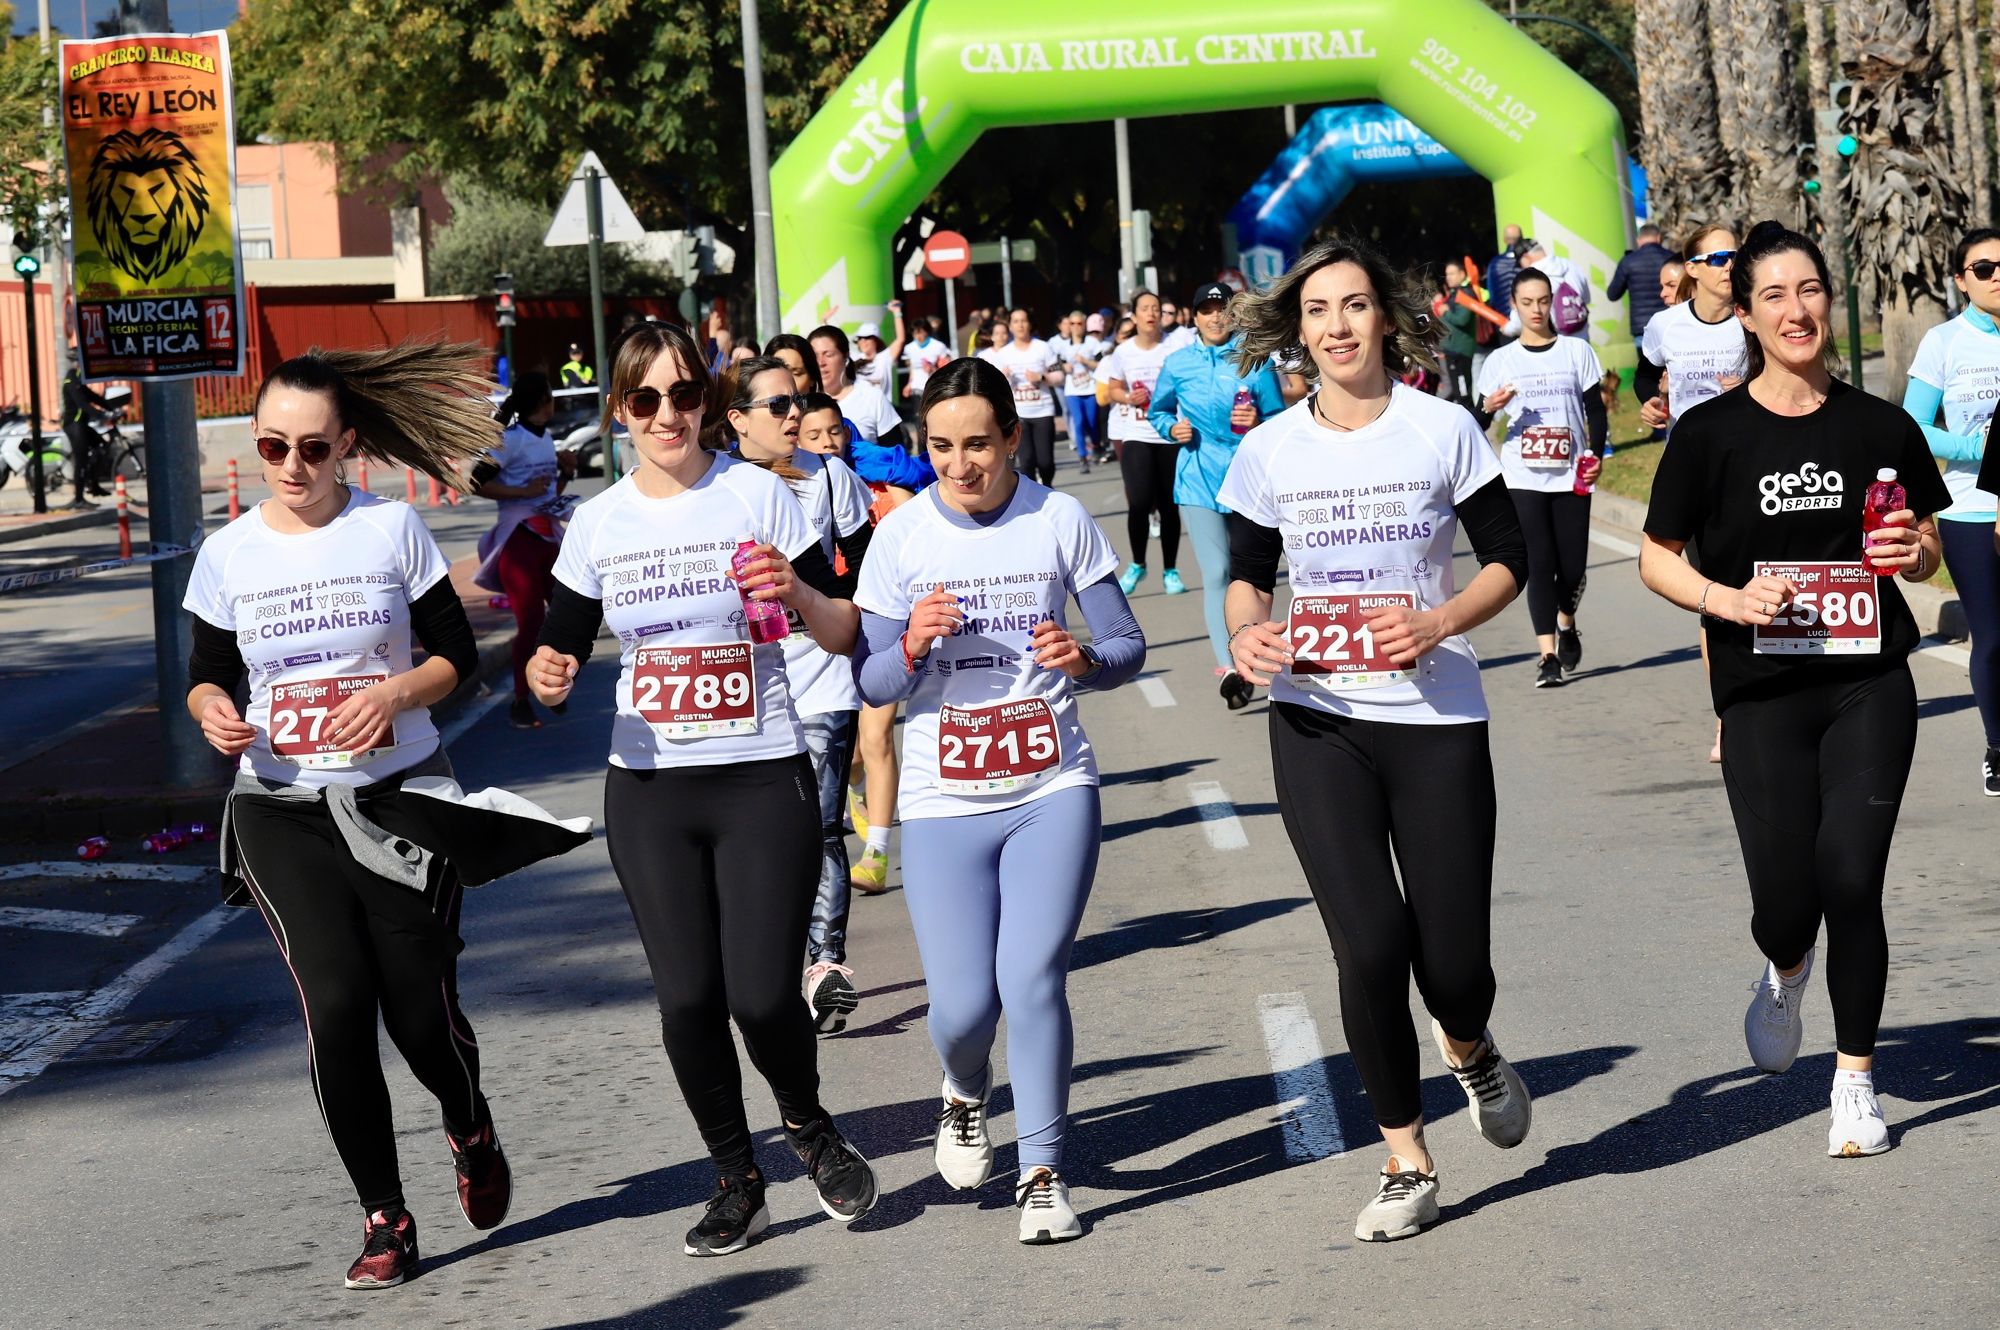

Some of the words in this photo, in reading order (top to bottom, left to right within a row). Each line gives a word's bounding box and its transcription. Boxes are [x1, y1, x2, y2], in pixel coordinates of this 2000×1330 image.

[960, 42, 1051, 74] CAJA
[1059, 37, 1189, 70] RURAL
[1195, 29, 1377, 65] CENTRAL
[69, 54, 106, 81] GRAN
[107, 46, 146, 67] CIRCO
[149, 46, 216, 74] ALASKA
[1419, 38, 1460, 74] 902
[1457, 67, 1498, 101] 104
[1496, 95, 1537, 130] 102
[69, 94, 93, 119] EL
[98, 91, 140, 119] REY
[148, 85, 217, 114] LEÓN
[1409, 57, 1523, 142] www.ruralcentral.es
[828, 79, 928, 185] CRC
[1353, 118, 1430, 145] UNIV
[1353, 144, 1411, 161] Instituto
[106, 299, 198, 324] MURCIA
[205, 305, 231, 340] 12
[82, 312, 105, 345] 24
[109, 323, 153, 335] RECINTO
[157, 321, 199, 333] FERIAL
[112, 336, 138, 356] LA
[142, 333, 200, 355] FICA
[1970, 366, 2000, 374] CARRERA
[1522, 438, 1570, 455] 2476
[1276, 494, 1294, 504] VIII
[1296, 490, 1340, 500] CARRERA
[1342, 489, 1355, 498] DE
[1358, 488, 1370, 497] LA
[1373, 483, 1405, 495] MUJER
[1407, 480, 1431, 491] 2023
[1298, 509, 1329, 525] POR
[1332, 499, 1355, 521] MÍ
[1359, 504, 1371, 519] Y
[1374, 502, 1407, 518] POR
[1786, 497, 1839, 510] SPORTS
[1305, 521, 1431, 548] COMPAÑERAS
[596, 558, 611, 569] VIII
[613, 551, 651, 565] CARRERA
[653, 548, 666, 558] DE
[669, 547, 681, 556] LA
[684, 543, 716, 554] MUJER
[719, 541, 739, 551] 202
[612, 570, 639, 586] POR
[642, 559, 665, 581] MÍ
[669, 563, 681, 577] Y
[684, 559, 718, 575] POR
[926, 579, 971, 592] CARERA
[974, 578, 986, 588] DE
[989, 577, 1001, 586] LA
[1004, 573, 1035, 585] MUJER
[1038, 571, 1058, 581] 2023
[1782, 572, 1821, 589] mujer
[1830, 567, 1870, 577] MURCIA
[257, 586, 298, 601] CARRERA
[301, 583, 313, 592] DE
[316, 580, 328, 589] LA
[330, 576, 363, 586] MUJER
[365, 575, 387, 585] 2023
[615, 577, 736, 608] COMPAÑERA
[255, 604, 287, 620] POR
[290, 592, 314, 613] MÍ
[317, 595, 329, 609] Y
[332, 592, 367, 607] POR
[964, 588, 988, 611] MÍ
[990, 594, 1003, 609] Y
[1005, 591, 1037, 608] POR
[1359, 597, 1408, 608] MURCIA
[1312, 602, 1350, 621] mujer
[260, 609, 391, 639] COMPAÑERAS
[1807, 629, 1832, 637] LUCÍA
[1294, 623, 1375, 661] 221
[655, 655, 692, 672] mujer
[701, 647, 747, 660] MURCIA
[1336, 664, 1368, 672] NOELIA
[287, 682, 308, 691] carrera
[291, 686, 329, 704] mujer
[338, 678, 380, 690] MURCIA
[636, 672, 750, 711] 2789
[673, 713, 714, 721] CRISTINA
[950, 710, 971, 718] carrera
[1001, 701, 1045, 717] MURCIA
[1015, 712, 1035, 721] MARZO
[1035, 709, 1048, 717] 2023
[955, 714, 992, 733] mujer
[315, 744, 337, 752] MYRI
[941, 724, 1055, 769] 2715
[986, 769, 1012, 778] ANITA
